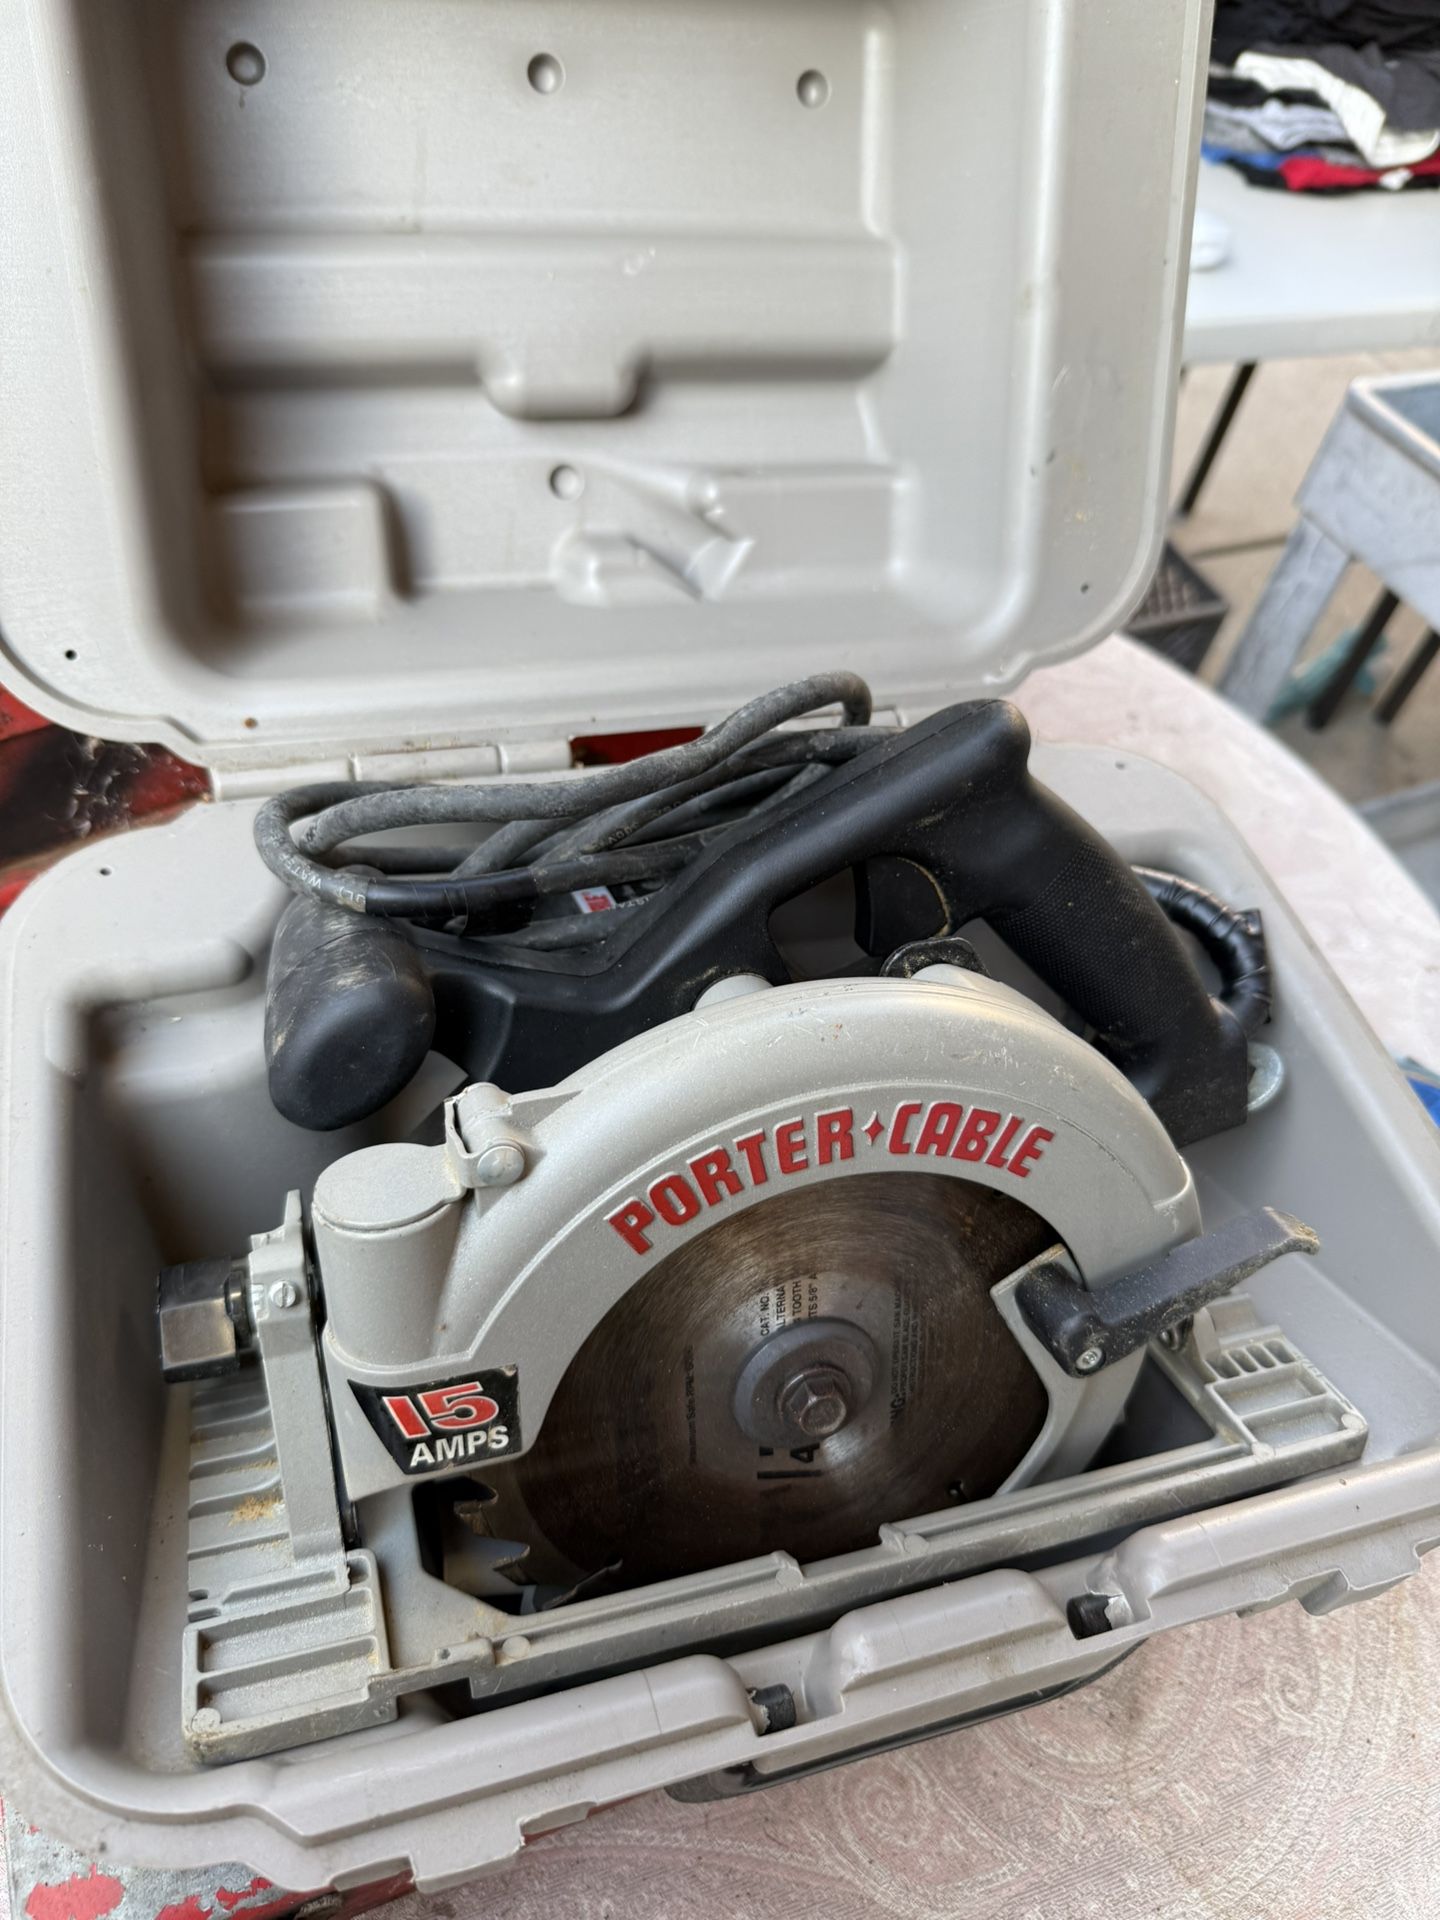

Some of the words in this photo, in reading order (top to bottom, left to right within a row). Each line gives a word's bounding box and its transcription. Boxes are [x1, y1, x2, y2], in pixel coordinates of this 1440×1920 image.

[604, 1106, 856, 1256] PORTER
[888, 1101, 1055, 1178] CABLE
[760, 1292, 770, 1312] NO.
[792, 1280, 802, 1316] TOOTH
[760, 1313, 770, 1336] CAT.
[382, 1381, 500, 1439] 15
[409, 1424, 510, 1468] AMPS
